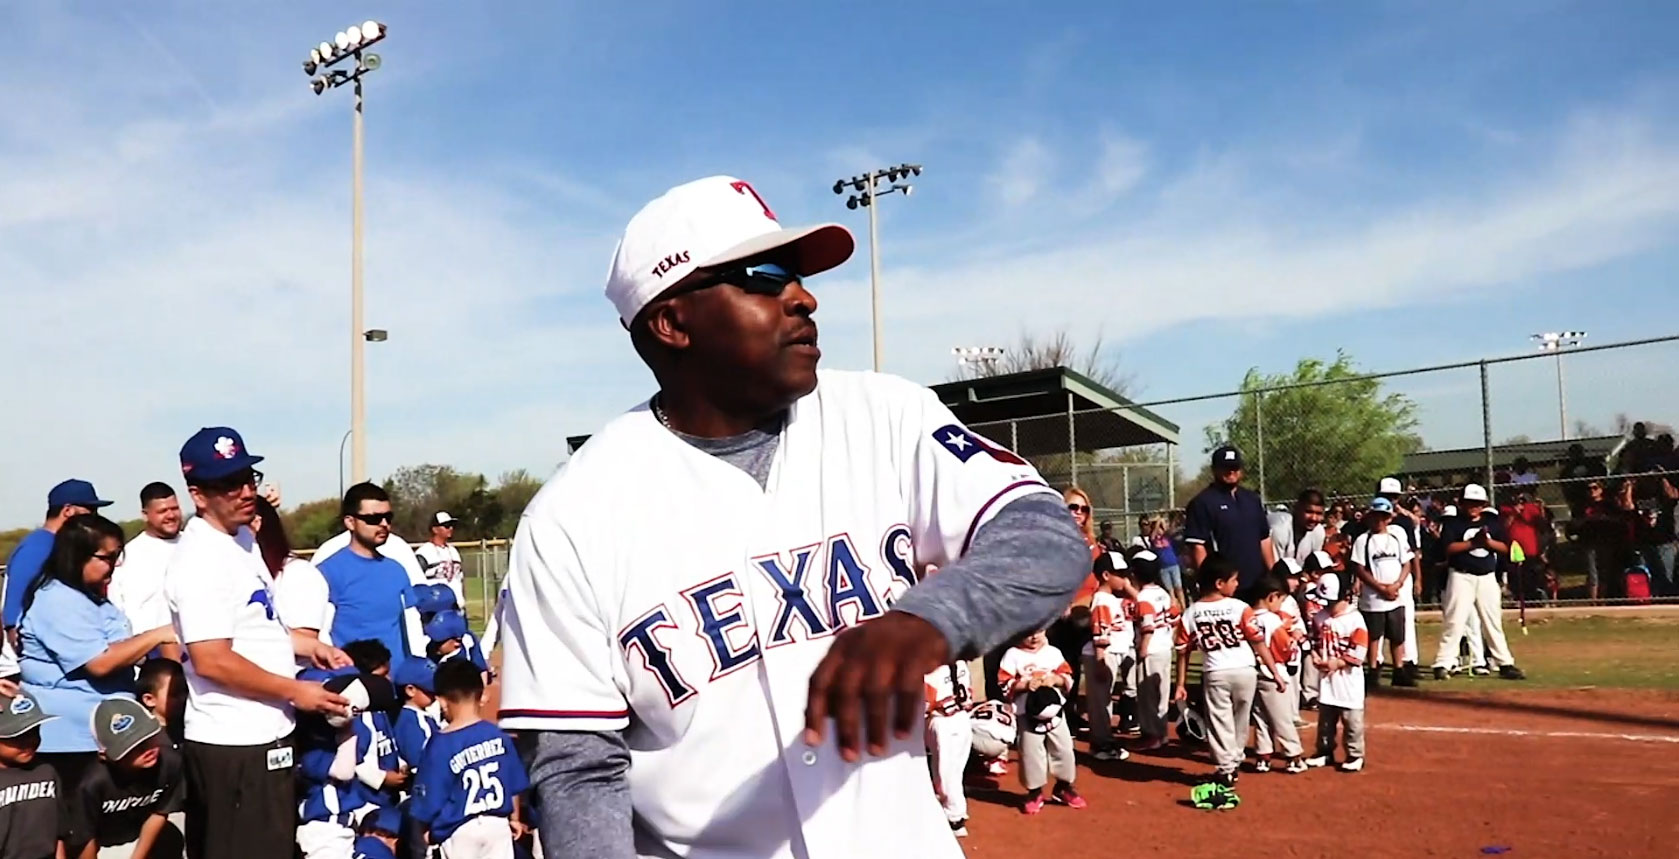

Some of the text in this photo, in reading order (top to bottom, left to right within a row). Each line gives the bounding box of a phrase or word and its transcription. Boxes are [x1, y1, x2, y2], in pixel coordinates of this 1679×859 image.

[651, 250, 690, 278] TEXAS
[617, 523, 918, 709] TEXAS
[449, 737, 505, 774] GUTIERREZ
[462, 761, 504, 816] 25
